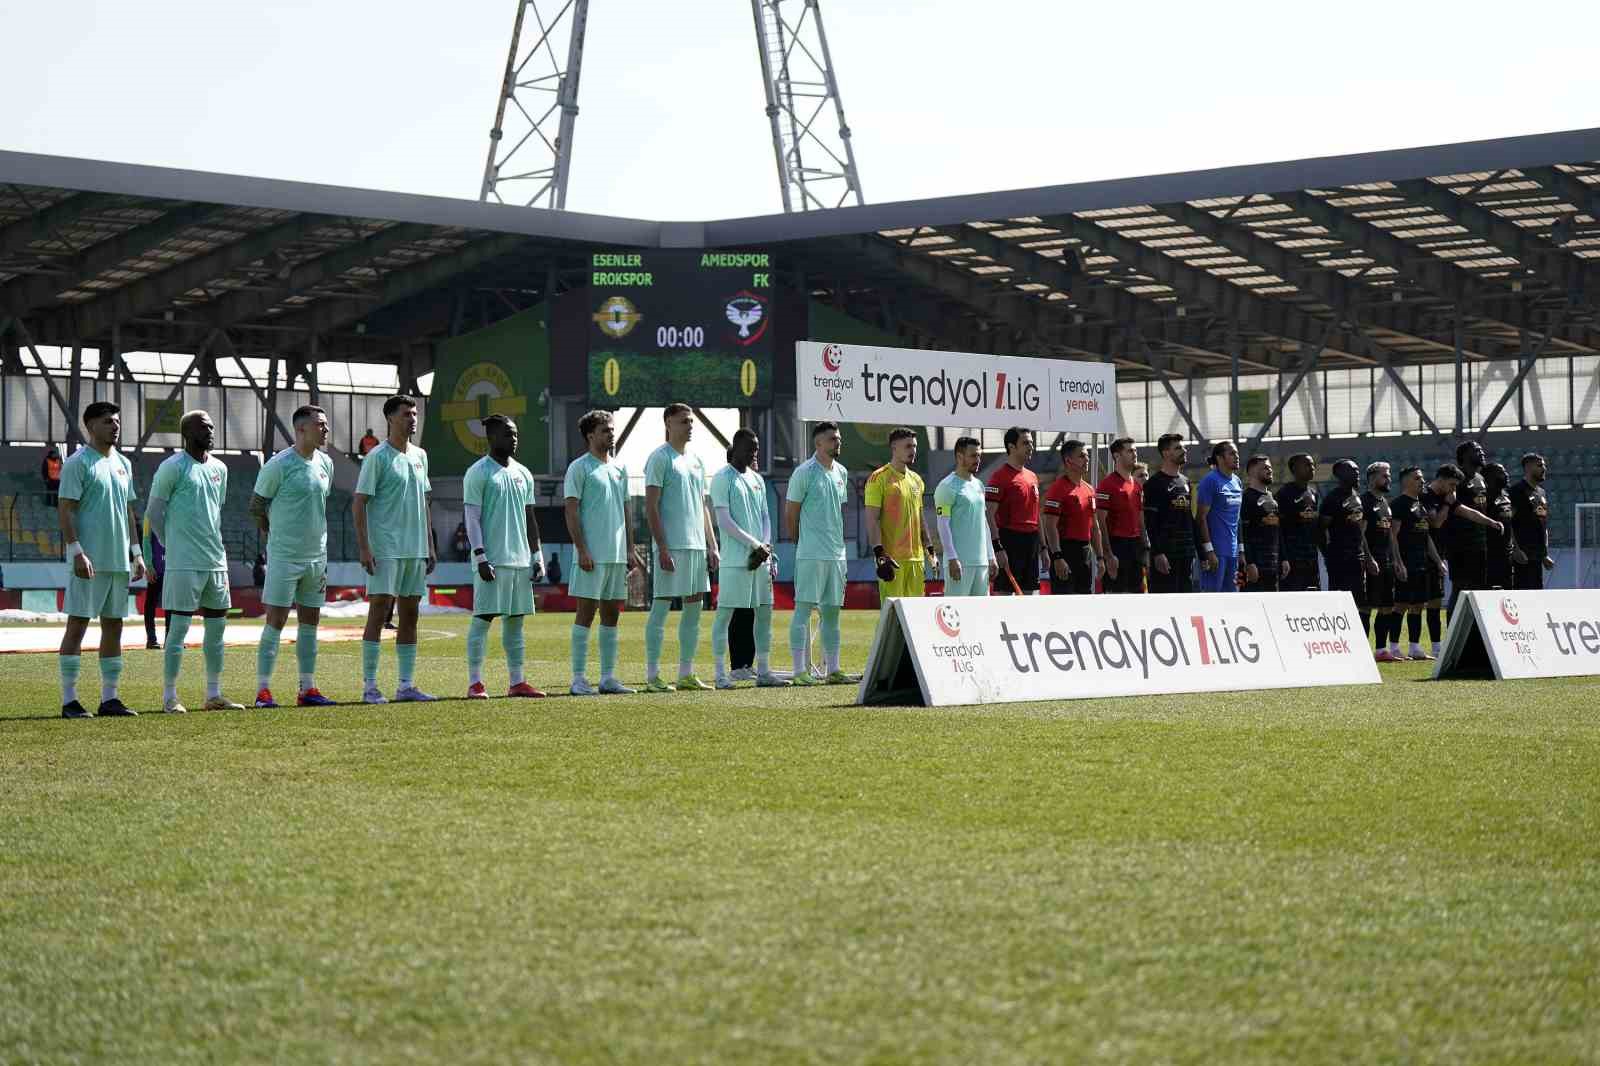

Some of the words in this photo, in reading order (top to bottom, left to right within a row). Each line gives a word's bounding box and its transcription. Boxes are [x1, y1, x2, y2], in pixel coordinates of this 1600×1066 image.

[593, 254, 642, 267] ESENLER
[701, 253, 770, 267] AMEDSPOR
[592, 272, 653, 286] EROKSPOR
[753, 273, 770, 287] FK
[656, 326, 705, 348] 00:00
[604, 358, 621, 396] 0
[740, 359, 757, 397] 0
[813, 375, 854, 391] trendyol
[1059, 377, 1105, 397] trendyol
[861, 363, 988, 415] trendyol
[1066, 398, 1100, 414] yemek
[1285, 612, 1351, 636] trendyol
[932, 641, 985, 660] trendyol
[999, 616, 1191, 680] trendyol
[1303, 637, 1351, 660] yemek
